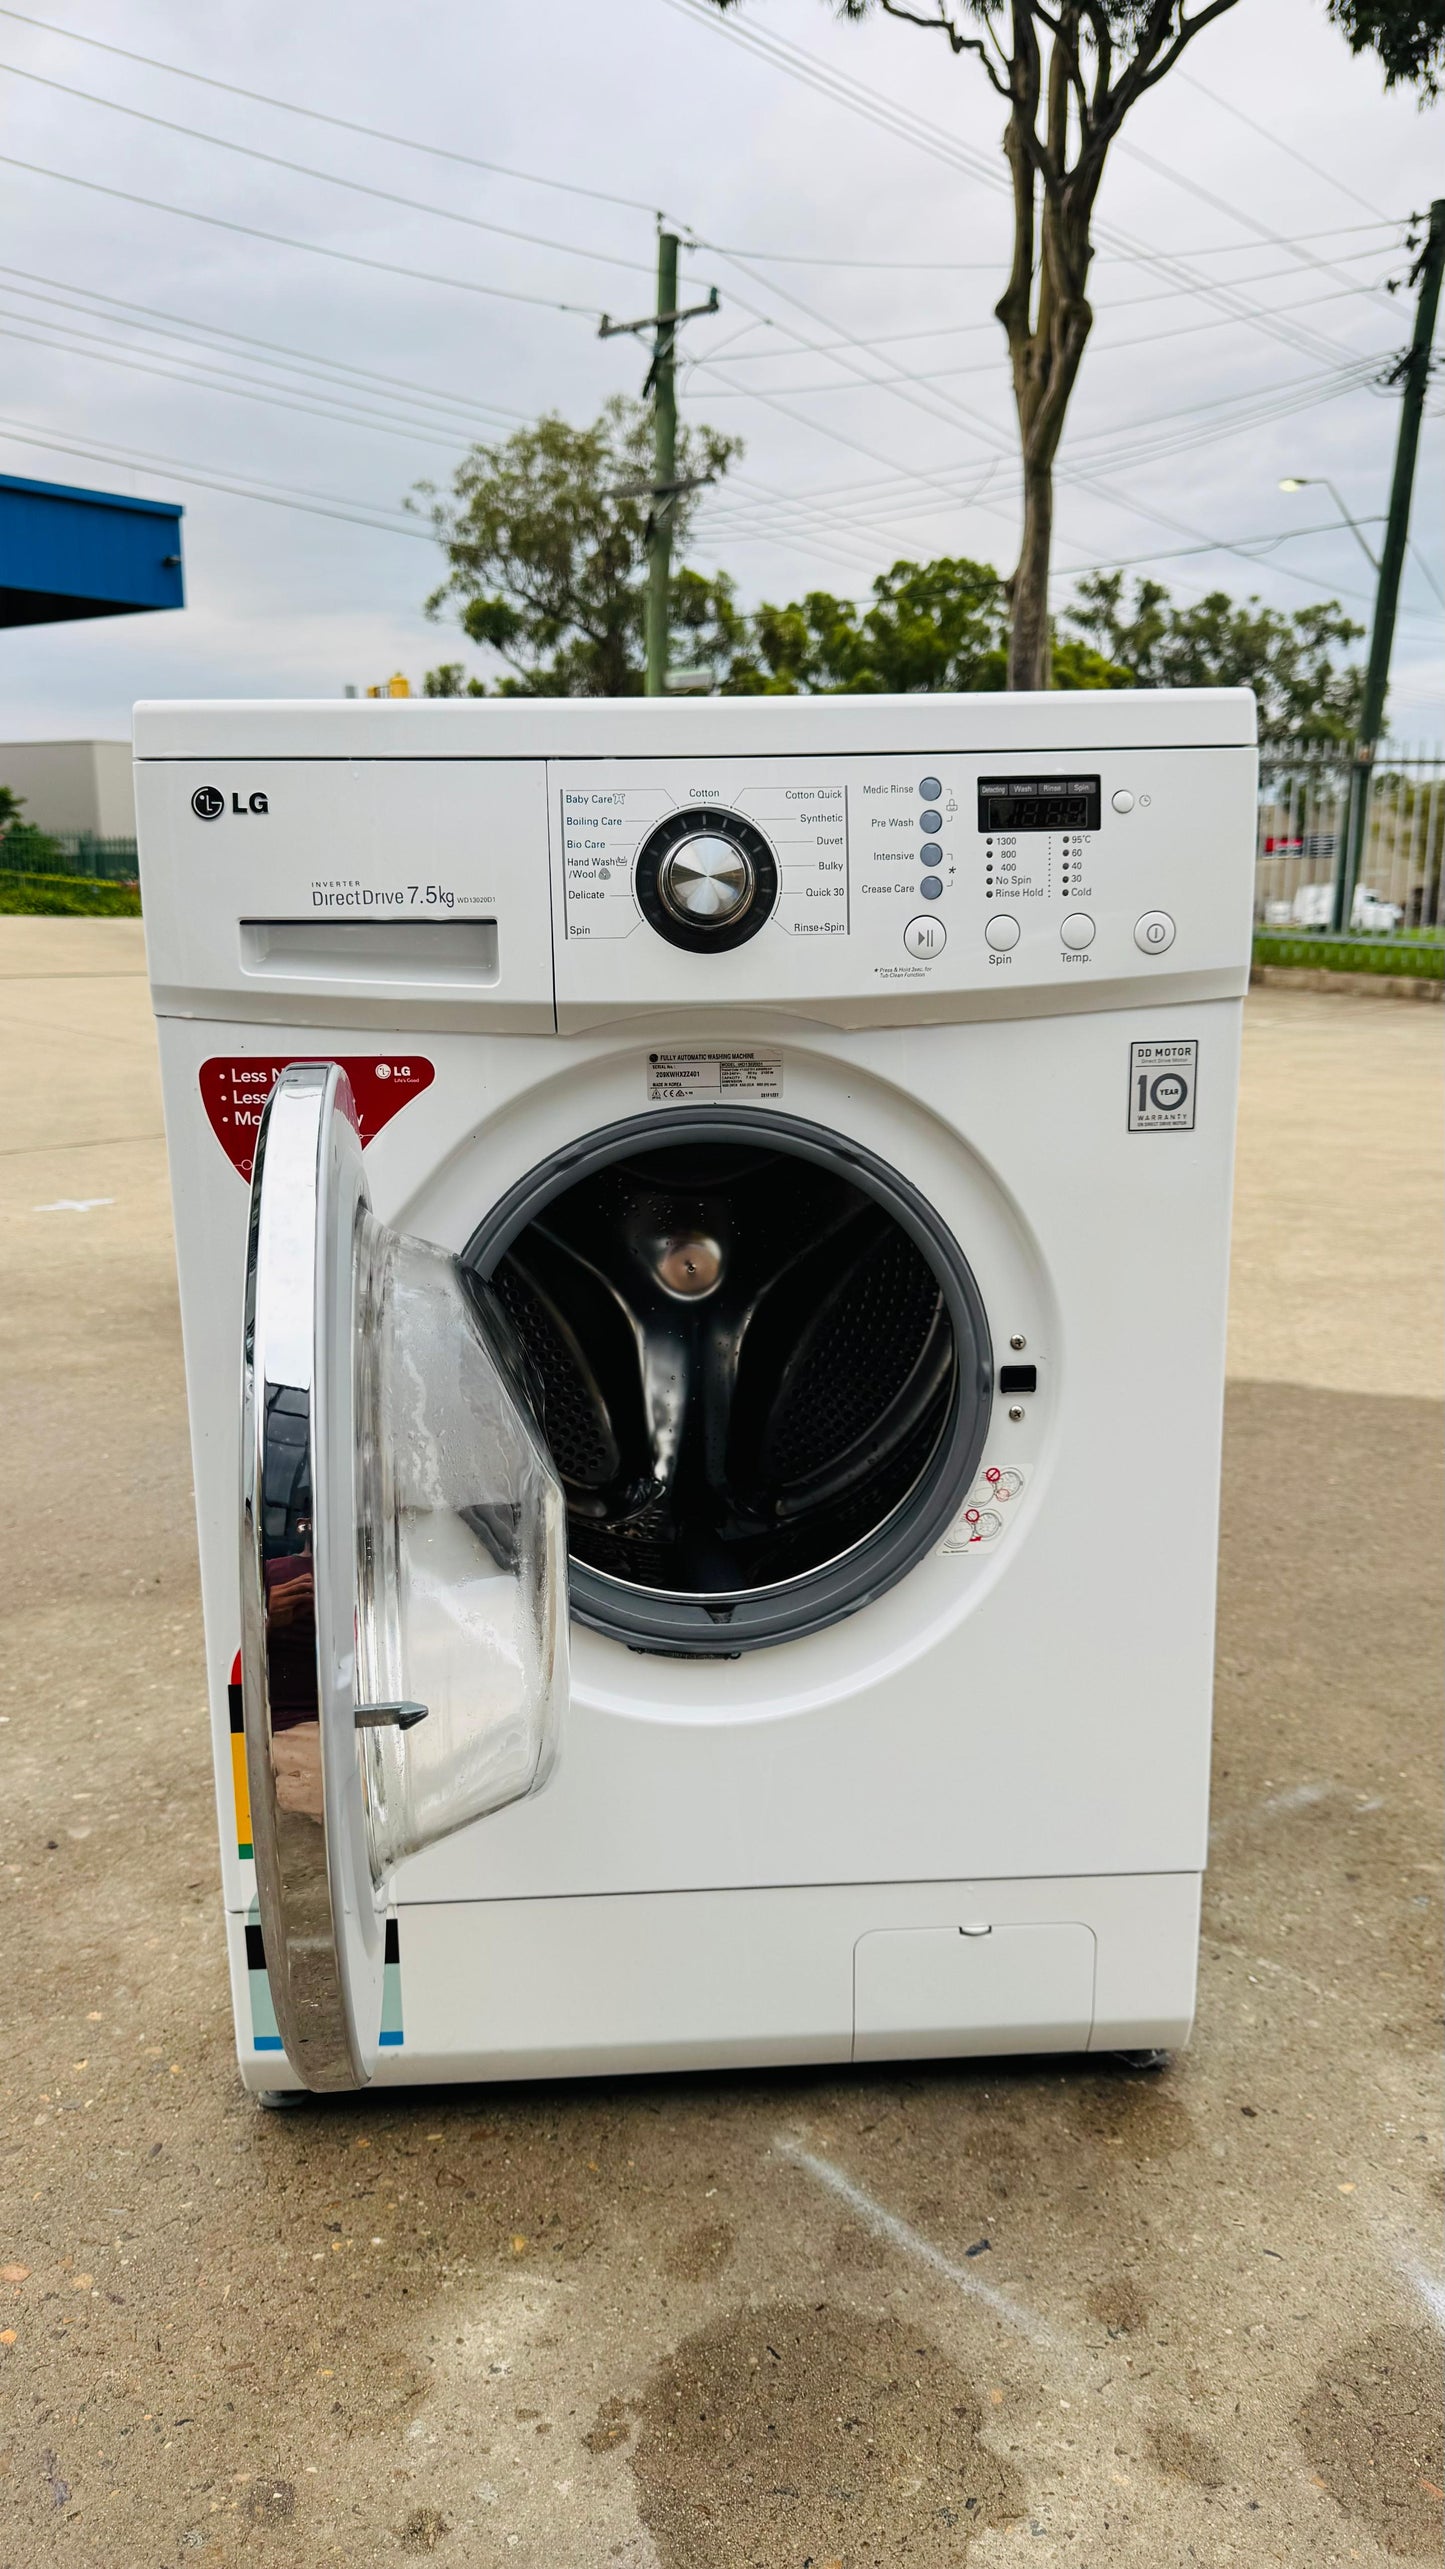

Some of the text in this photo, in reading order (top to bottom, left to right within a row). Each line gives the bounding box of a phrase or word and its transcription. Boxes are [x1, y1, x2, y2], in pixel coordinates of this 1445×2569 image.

[863, 784, 914, 796] Medic Rinse
[981, 786, 1006, 795] Detecting
[1014, 785, 1032, 793] Wash
[1043, 784, 1061, 792] Rinse
[1073, 783, 1090, 792] Spin
[689, 788, 720, 798] Cotton
[785, 789, 843, 801] Cotton Quick
[231, 791, 269, 814] LG
[566, 793, 613, 805] Baby Care
[566, 816, 622, 828] Boiling Care
[800, 812, 843, 825] Synthetic
[871, 817, 914, 828] Pre Wash
[567, 839, 606, 850] Bio Care
[816, 836, 843, 846] Duvet
[996, 837, 1017, 845] 1300
[873, 851, 915, 862] Intensive
[1001, 850, 1017, 859] 800
[1071, 849, 1083, 857] 60
[567, 857, 616, 867] Hand Wash
[818, 861, 844, 873] Bulky
[1071, 862, 1083, 870] 40
[1001, 863, 1017, 872] 400
[568, 869, 597, 879] /Wool
[1071, 875, 1082, 883] 30
[311, 880, 361, 888] INVERTER
[996, 876, 1032, 887] No Spin
[805, 887, 845, 898] Quick 30
[861, 884, 915, 894] Crease Care
[995, 888, 1044, 898] Rinse Hold
[1071, 887, 1092, 897] Cold
[407, 885, 455, 908] 7.5kg
[568, 890, 605, 900] Delicate
[569, 925, 591, 937] Spin
[794, 922, 845, 935] Rinse+Spin
[988, 953, 1012, 967] Spin
[1060, 952, 1092, 964] Temp.
[677, 1053, 707, 1061] AUTOMATIC
[1138, 1047, 1192, 1058] DD MOTOR
[231, 1068, 267, 1083] Less
[393, 1066, 411, 1077] LG
[233, 1090, 268, 1104] Less
[1137, 1072, 1188, 1112] 10
[1160, 1088, 1179, 1096] YEAR
[1137, 1113, 1187, 1121] WARRANTY
